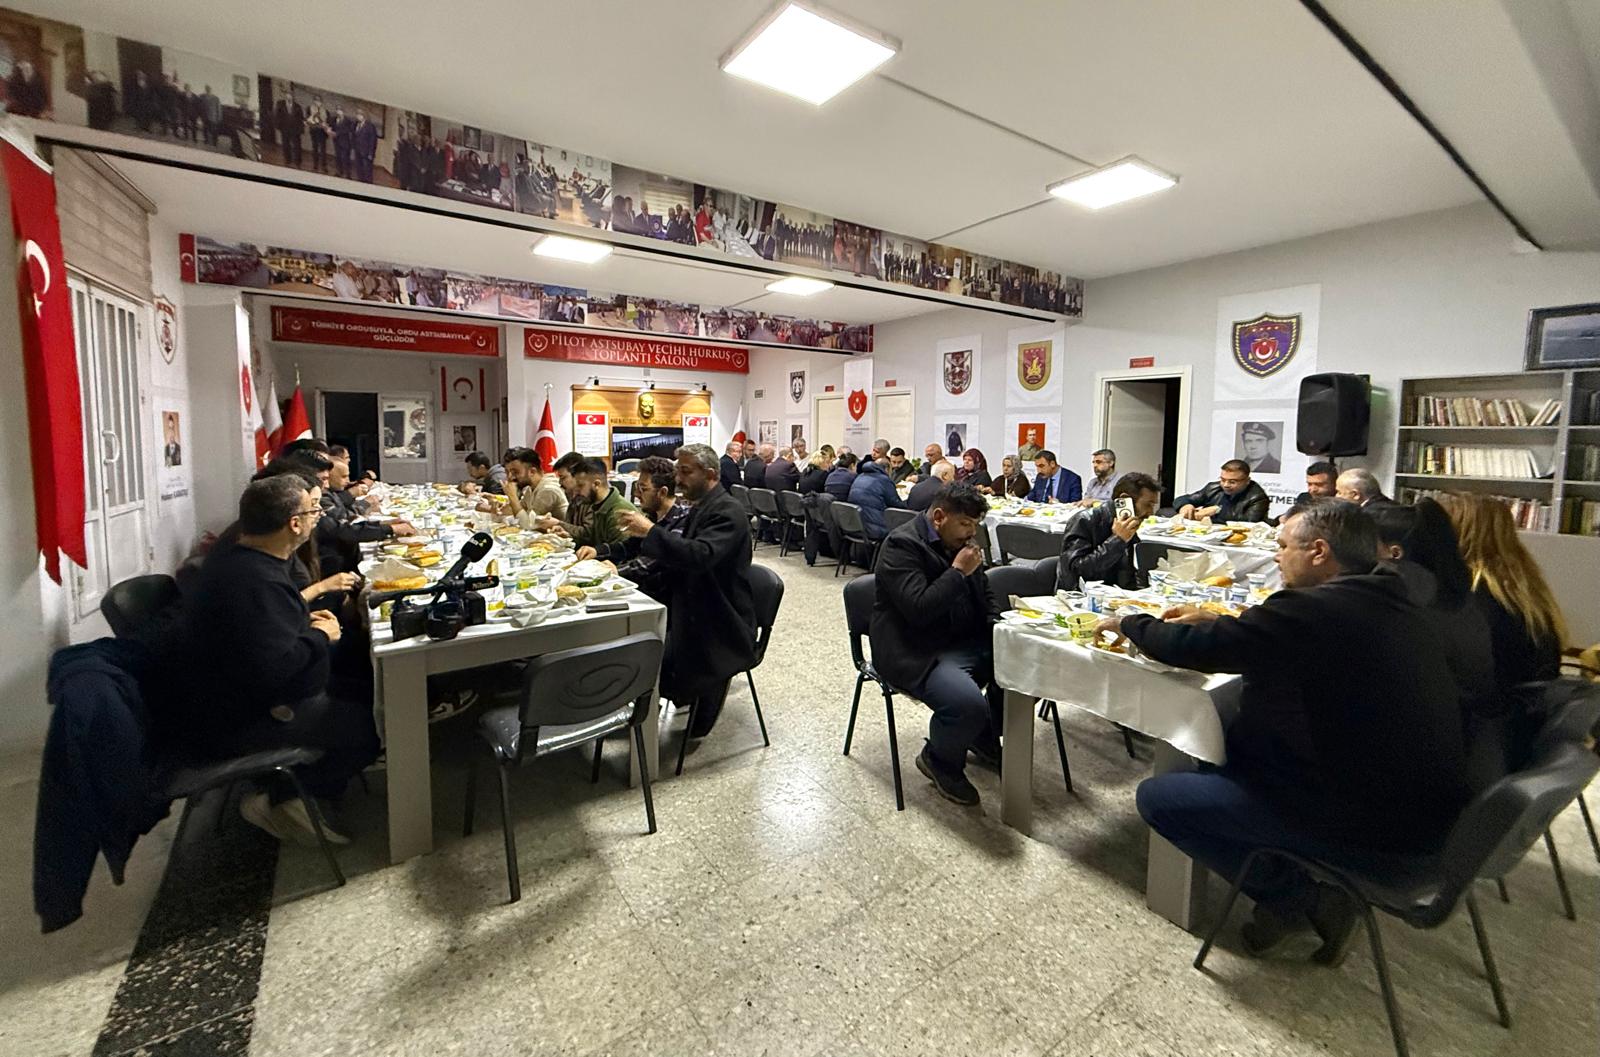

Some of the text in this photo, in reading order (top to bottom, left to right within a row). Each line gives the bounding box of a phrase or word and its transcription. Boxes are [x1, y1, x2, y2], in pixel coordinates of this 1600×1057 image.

[397, 328, 419, 337] ORDU
[551, 333, 731, 362] PİLOT ASTSUBAY VECİHİ HÜRKUŞ
[593, 348, 698, 367] TOPLANTI SALONU
